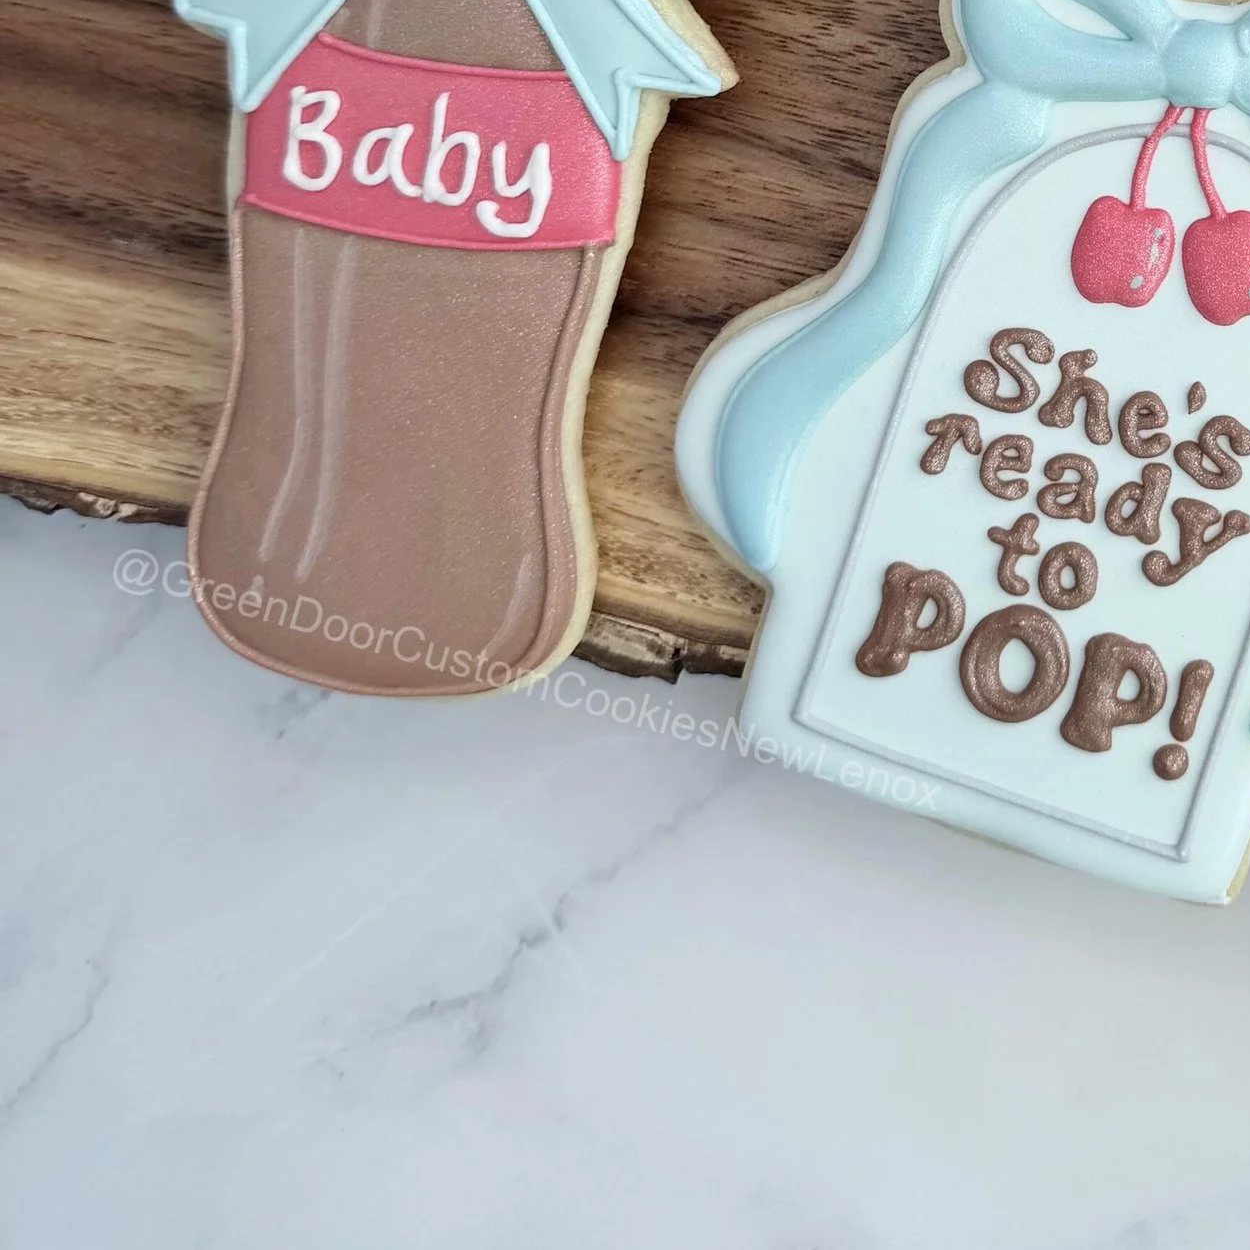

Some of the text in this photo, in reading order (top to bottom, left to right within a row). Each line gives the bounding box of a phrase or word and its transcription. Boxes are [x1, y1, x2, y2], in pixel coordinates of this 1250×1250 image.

[282, 85, 552, 239] Baby
[987, 513, 1099, 611] to
[855, 561, 1215, 781] POP!
